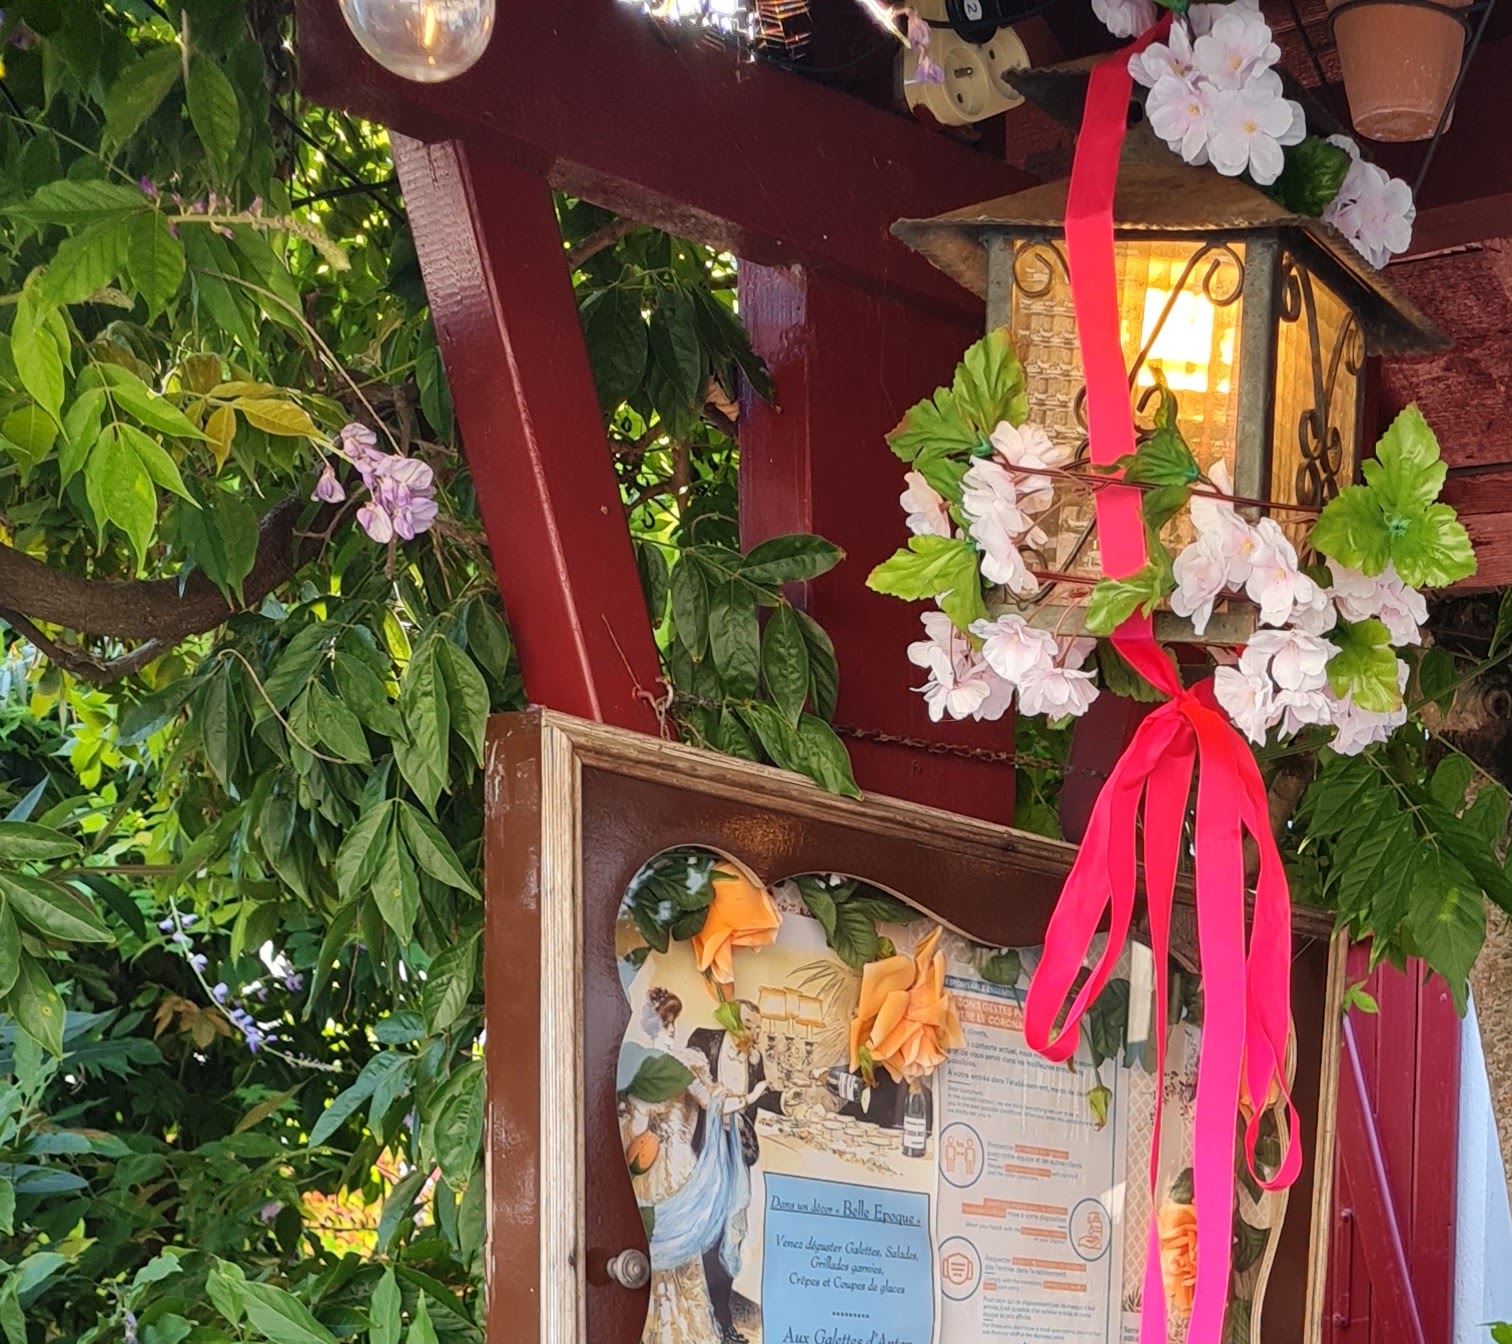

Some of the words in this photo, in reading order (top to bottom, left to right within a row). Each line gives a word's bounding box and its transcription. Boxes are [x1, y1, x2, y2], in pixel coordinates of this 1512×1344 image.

[770, 1195, 795, 1210] Dans
[797, 1202, 809, 1211] un
[843, 1199, 869, 1219] Belle
[873, 1203, 915, 1226] Epoque
[776, 1234, 804, 1249] Venez
[805, 1236, 842, 1254] déguster
[845, 1241, 882, 1258] Galettes,
[884, 1245, 919, 1262] Salades,
[810, 1256, 849, 1272] Grillades
[851, 1262, 884, 1275] garnies,
[789, 1271, 820, 1287] Crêpes
[822, 1277, 831, 1287] et
[833, 1277, 865, 1291] Coupes
[867, 1278, 878, 1291] de
[880, 1279, 905, 1295] glaces
[782, 1326, 810, 1344] Aux
